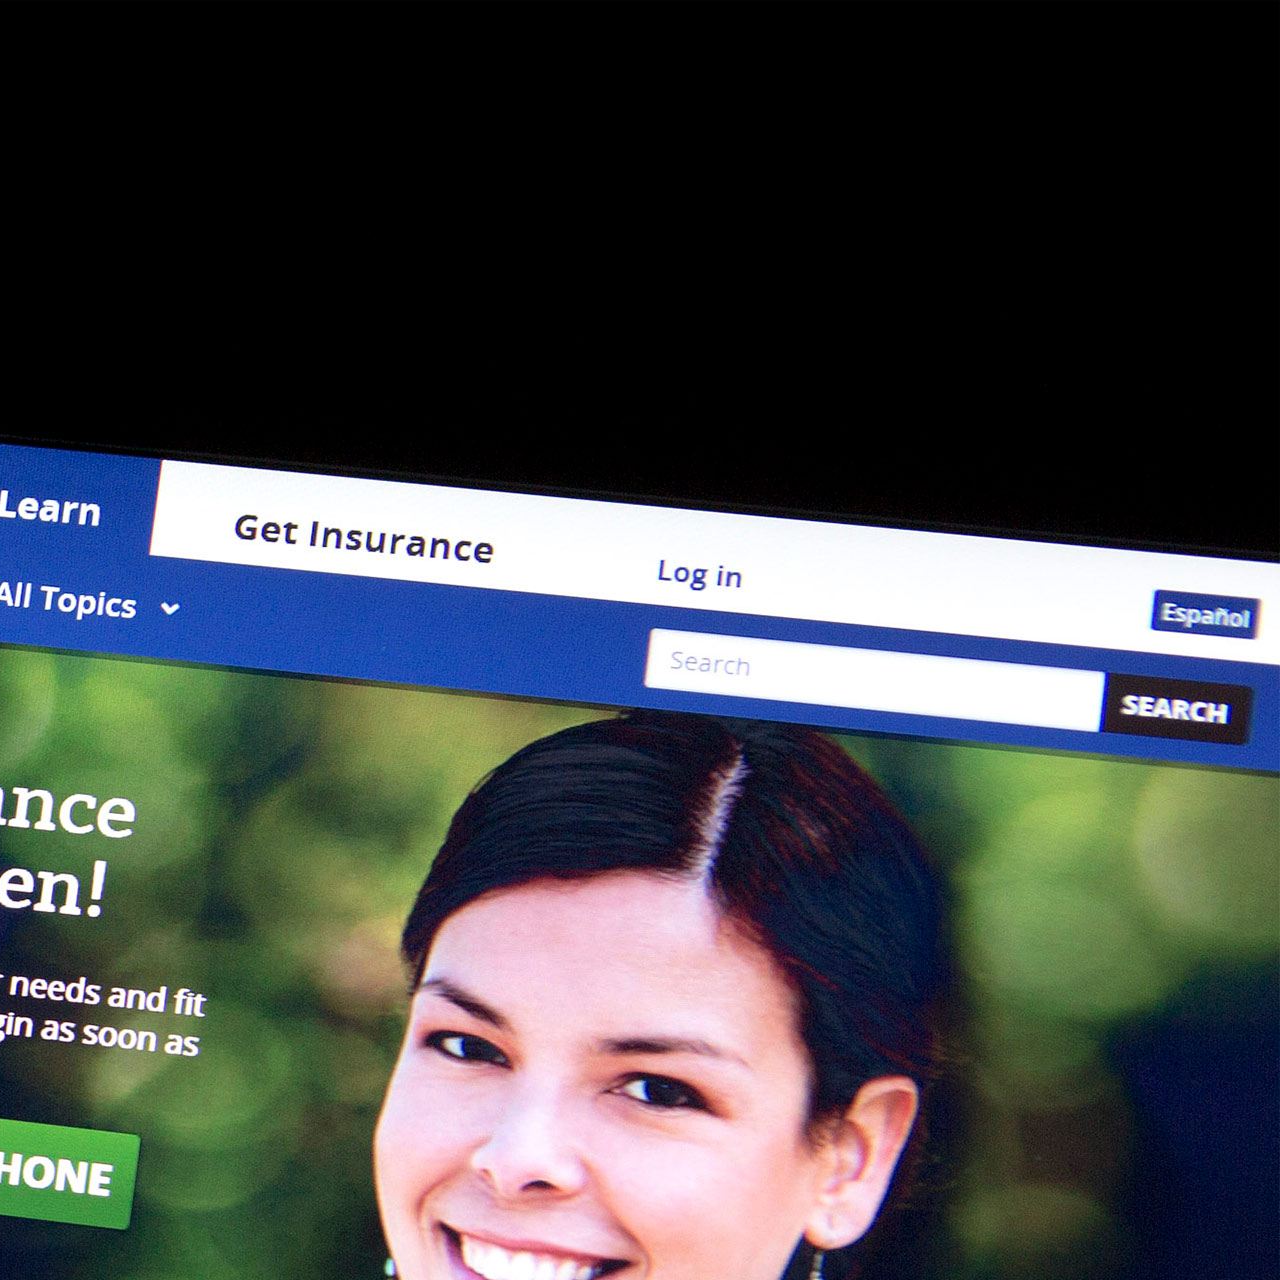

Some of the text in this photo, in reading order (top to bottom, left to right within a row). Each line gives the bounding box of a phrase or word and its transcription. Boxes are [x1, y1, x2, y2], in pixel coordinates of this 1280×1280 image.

[234, 514, 495, 564] Get Insurance
[657, 559, 742, 592] Log in
[40, 585, 137, 621] Topics
[1161, 602, 1250, 628] Español
[669, 650, 750, 677] Search
[1120, 694, 1228, 724] SEARCH
[9, 975, 102, 1005] needs
[107, 985, 168, 1013] and
[173, 987, 208, 1018] fit
[40, 1019, 76, 1043] as
[81, 1024, 158, 1053] soon
[163, 1033, 201, 1057] as
